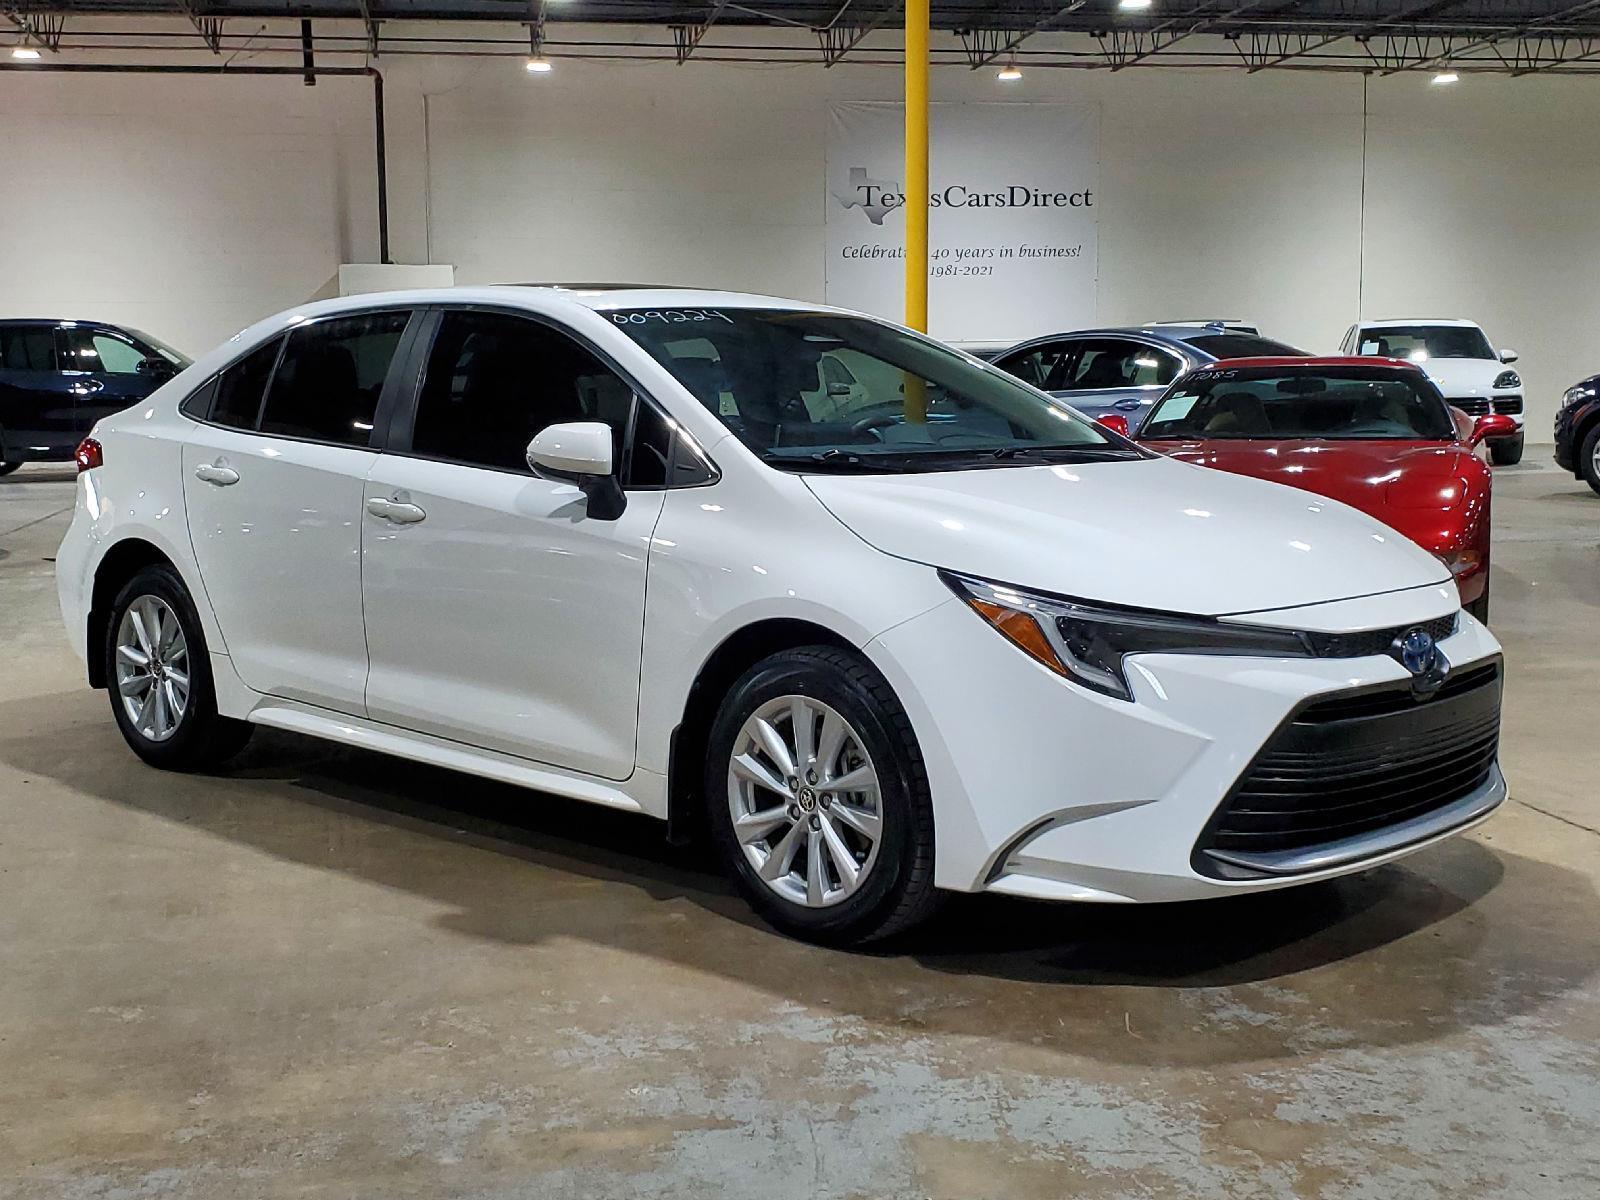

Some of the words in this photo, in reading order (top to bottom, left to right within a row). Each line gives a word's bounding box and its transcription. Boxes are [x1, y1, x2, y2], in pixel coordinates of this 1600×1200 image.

[857, 185, 1093, 208] TexsCarsDirect
[842, 244, 907, 259] Celebrat
[931, 248, 950, 260] 40
[955, 247, 994, 262] years
[999, 246, 1013, 258] in
[1018, 243, 1081, 258] business!
[930, 264, 993, 278] 1981-2021
[612, 310, 735, 324] 009224
